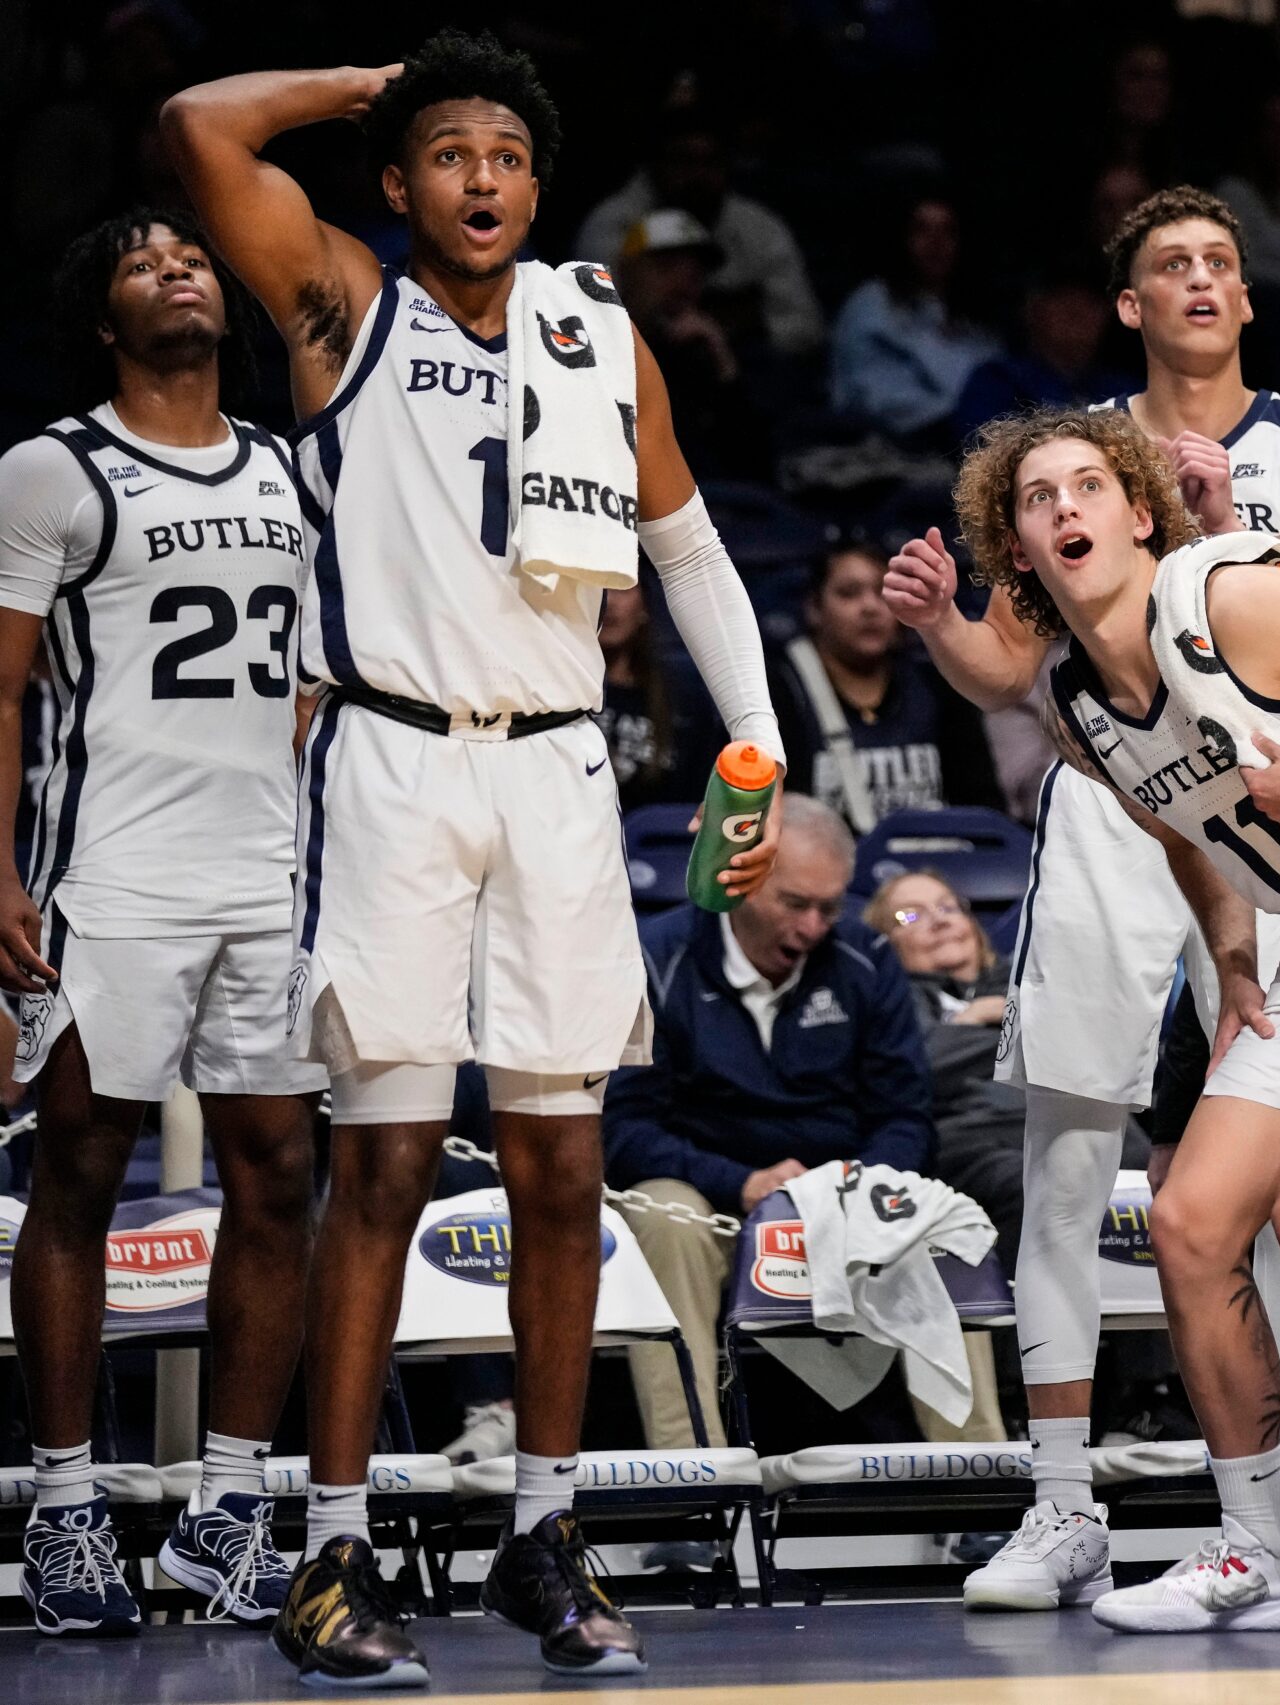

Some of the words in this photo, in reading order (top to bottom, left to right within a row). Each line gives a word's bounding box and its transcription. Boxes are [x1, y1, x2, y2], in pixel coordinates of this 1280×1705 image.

[413, 298, 426, 307] BE
[408, 304, 447, 318] CHANGE
[406, 358, 510, 405] BUT
[107, 467, 121, 476] BE
[121, 464, 137, 474] THE
[1231, 469, 1267, 479] EAST
[1235, 463, 1260, 471] BIG
[107, 470, 142, 482] CHANGE
[259, 480, 279, 488] BIG
[258, 487, 287, 496] EAST
[468, 435, 510, 558] 1
[521, 471, 639, 533] GATOR
[143, 516, 304, 563] BUTLER
[148, 584, 299, 700] 23
[1091, 713, 1106, 729] THE
[1087, 721, 1112, 740] HANGE
[106, 1237, 196, 1266] bryant
[179, 1278, 209, 1292] System
[574, 1459, 718, 1488] ULLDOGS
[859, 1452, 1032, 1480] BULLDOGS
